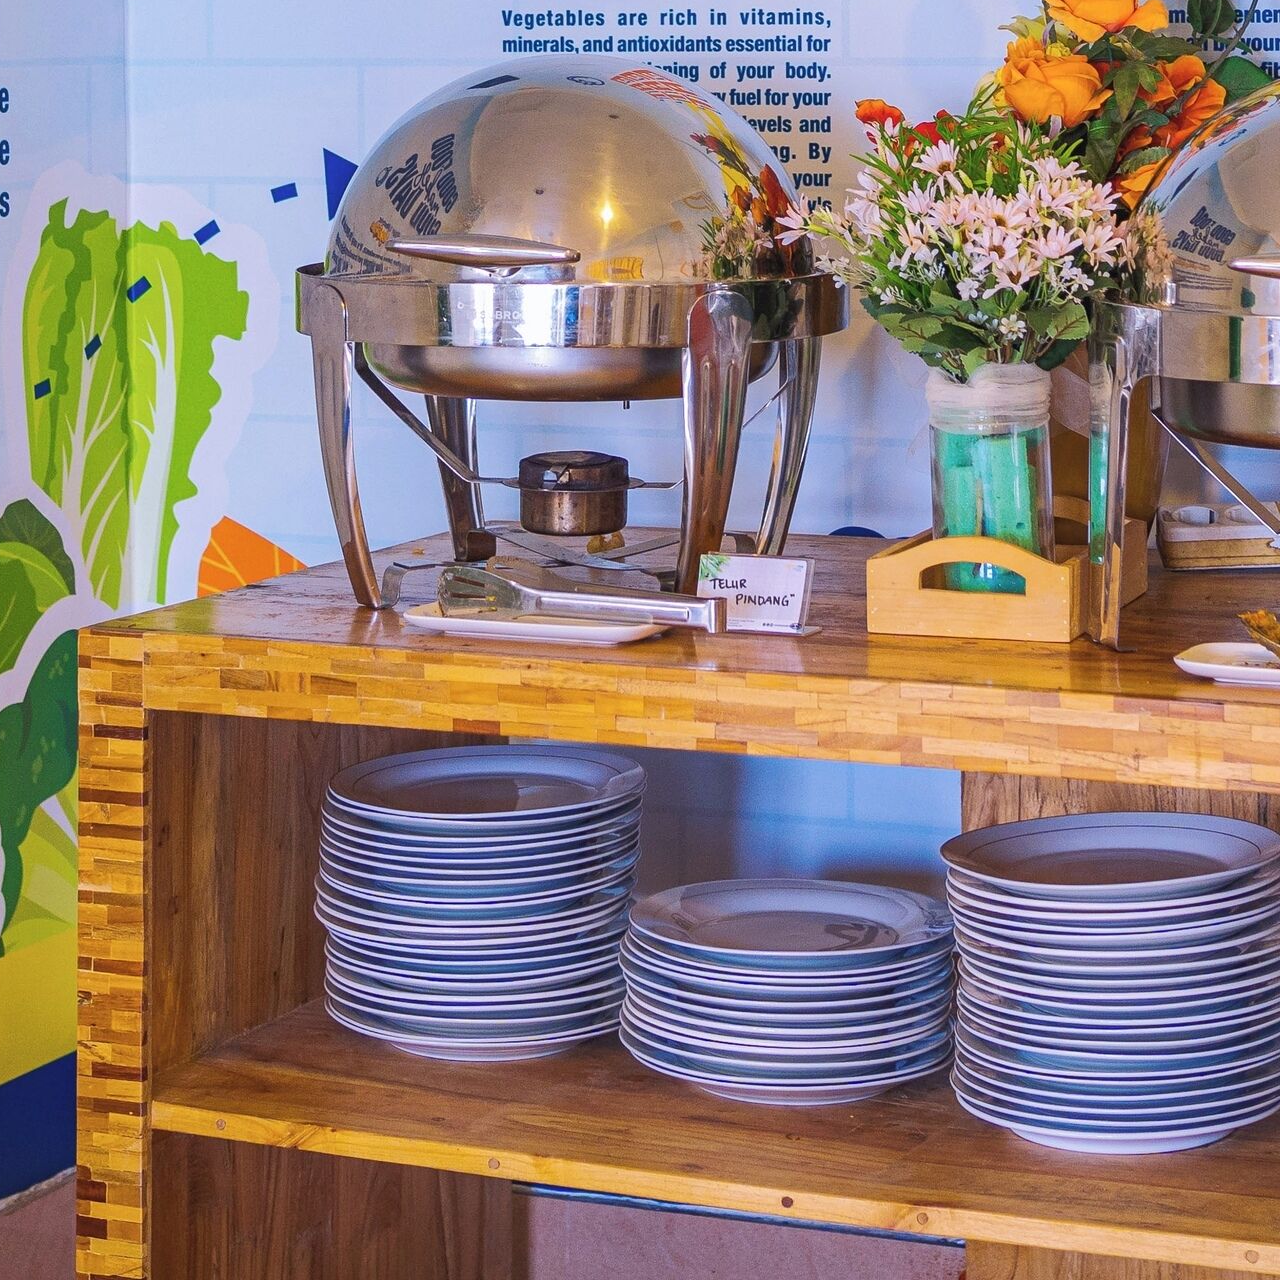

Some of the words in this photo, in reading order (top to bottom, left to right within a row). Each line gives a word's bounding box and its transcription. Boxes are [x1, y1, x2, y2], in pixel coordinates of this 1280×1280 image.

[501, 9, 605, 31] Vegetables
[617, 12, 648, 26] are
[660, 8, 697, 26] rich
[710, 8, 727, 26] in
[739, 8, 831, 29] vitamins,
[502, 36, 580, 55] minerals,
[583, 35, 614, 53] and
[617, 35, 722, 53] antioxidants
[725, 34, 803, 52] essential
[806, 34, 831, 52] for
[709, 61, 727, 79] of
[736, 65, 775, 83] your
[785, 61, 832, 83] body.
[729, 89, 761, 106] fuel
[764, 89, 789, 106] for
[792, 91, 832, 110] your
[799, 115, 832, 133] and
[808, 142, 832, 164] By
[792, 172, 833, 190] your
